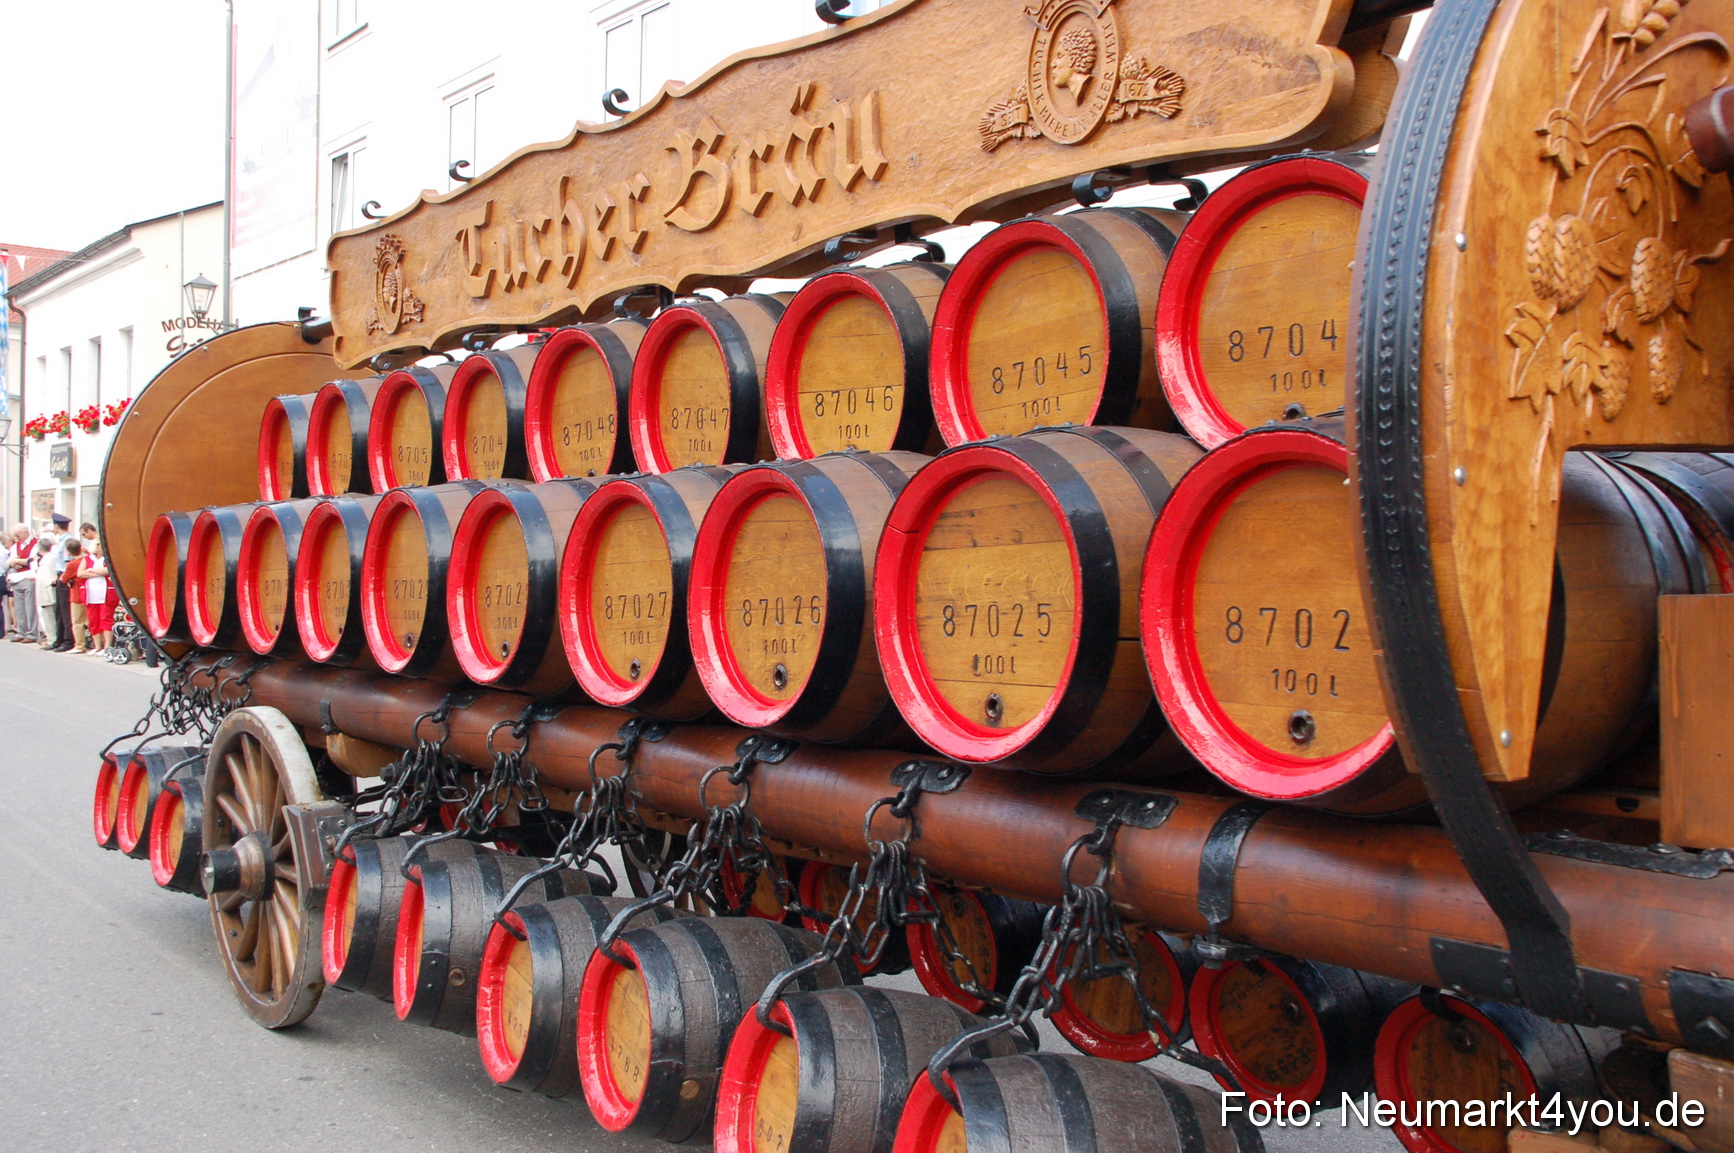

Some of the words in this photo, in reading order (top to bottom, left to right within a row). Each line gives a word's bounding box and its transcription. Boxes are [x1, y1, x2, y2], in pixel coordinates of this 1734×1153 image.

[1124, 82, 1149, 99] 1672
[456, 172, 651, 299] Tucher
[664, 80, 889, 233] Bräu
[992, 345, 1092, 395] 87045
[814, 385, 894, 417] 87046
[563, 413, 615, 446] 87048
[671, 407, 729, 431] 87047
[394, 579, 428, 600] 8702
[605, 591, 667, 620] 87027
[742, 595, 821, 627] 87026
[942, 603, 1052, 638] 87025
